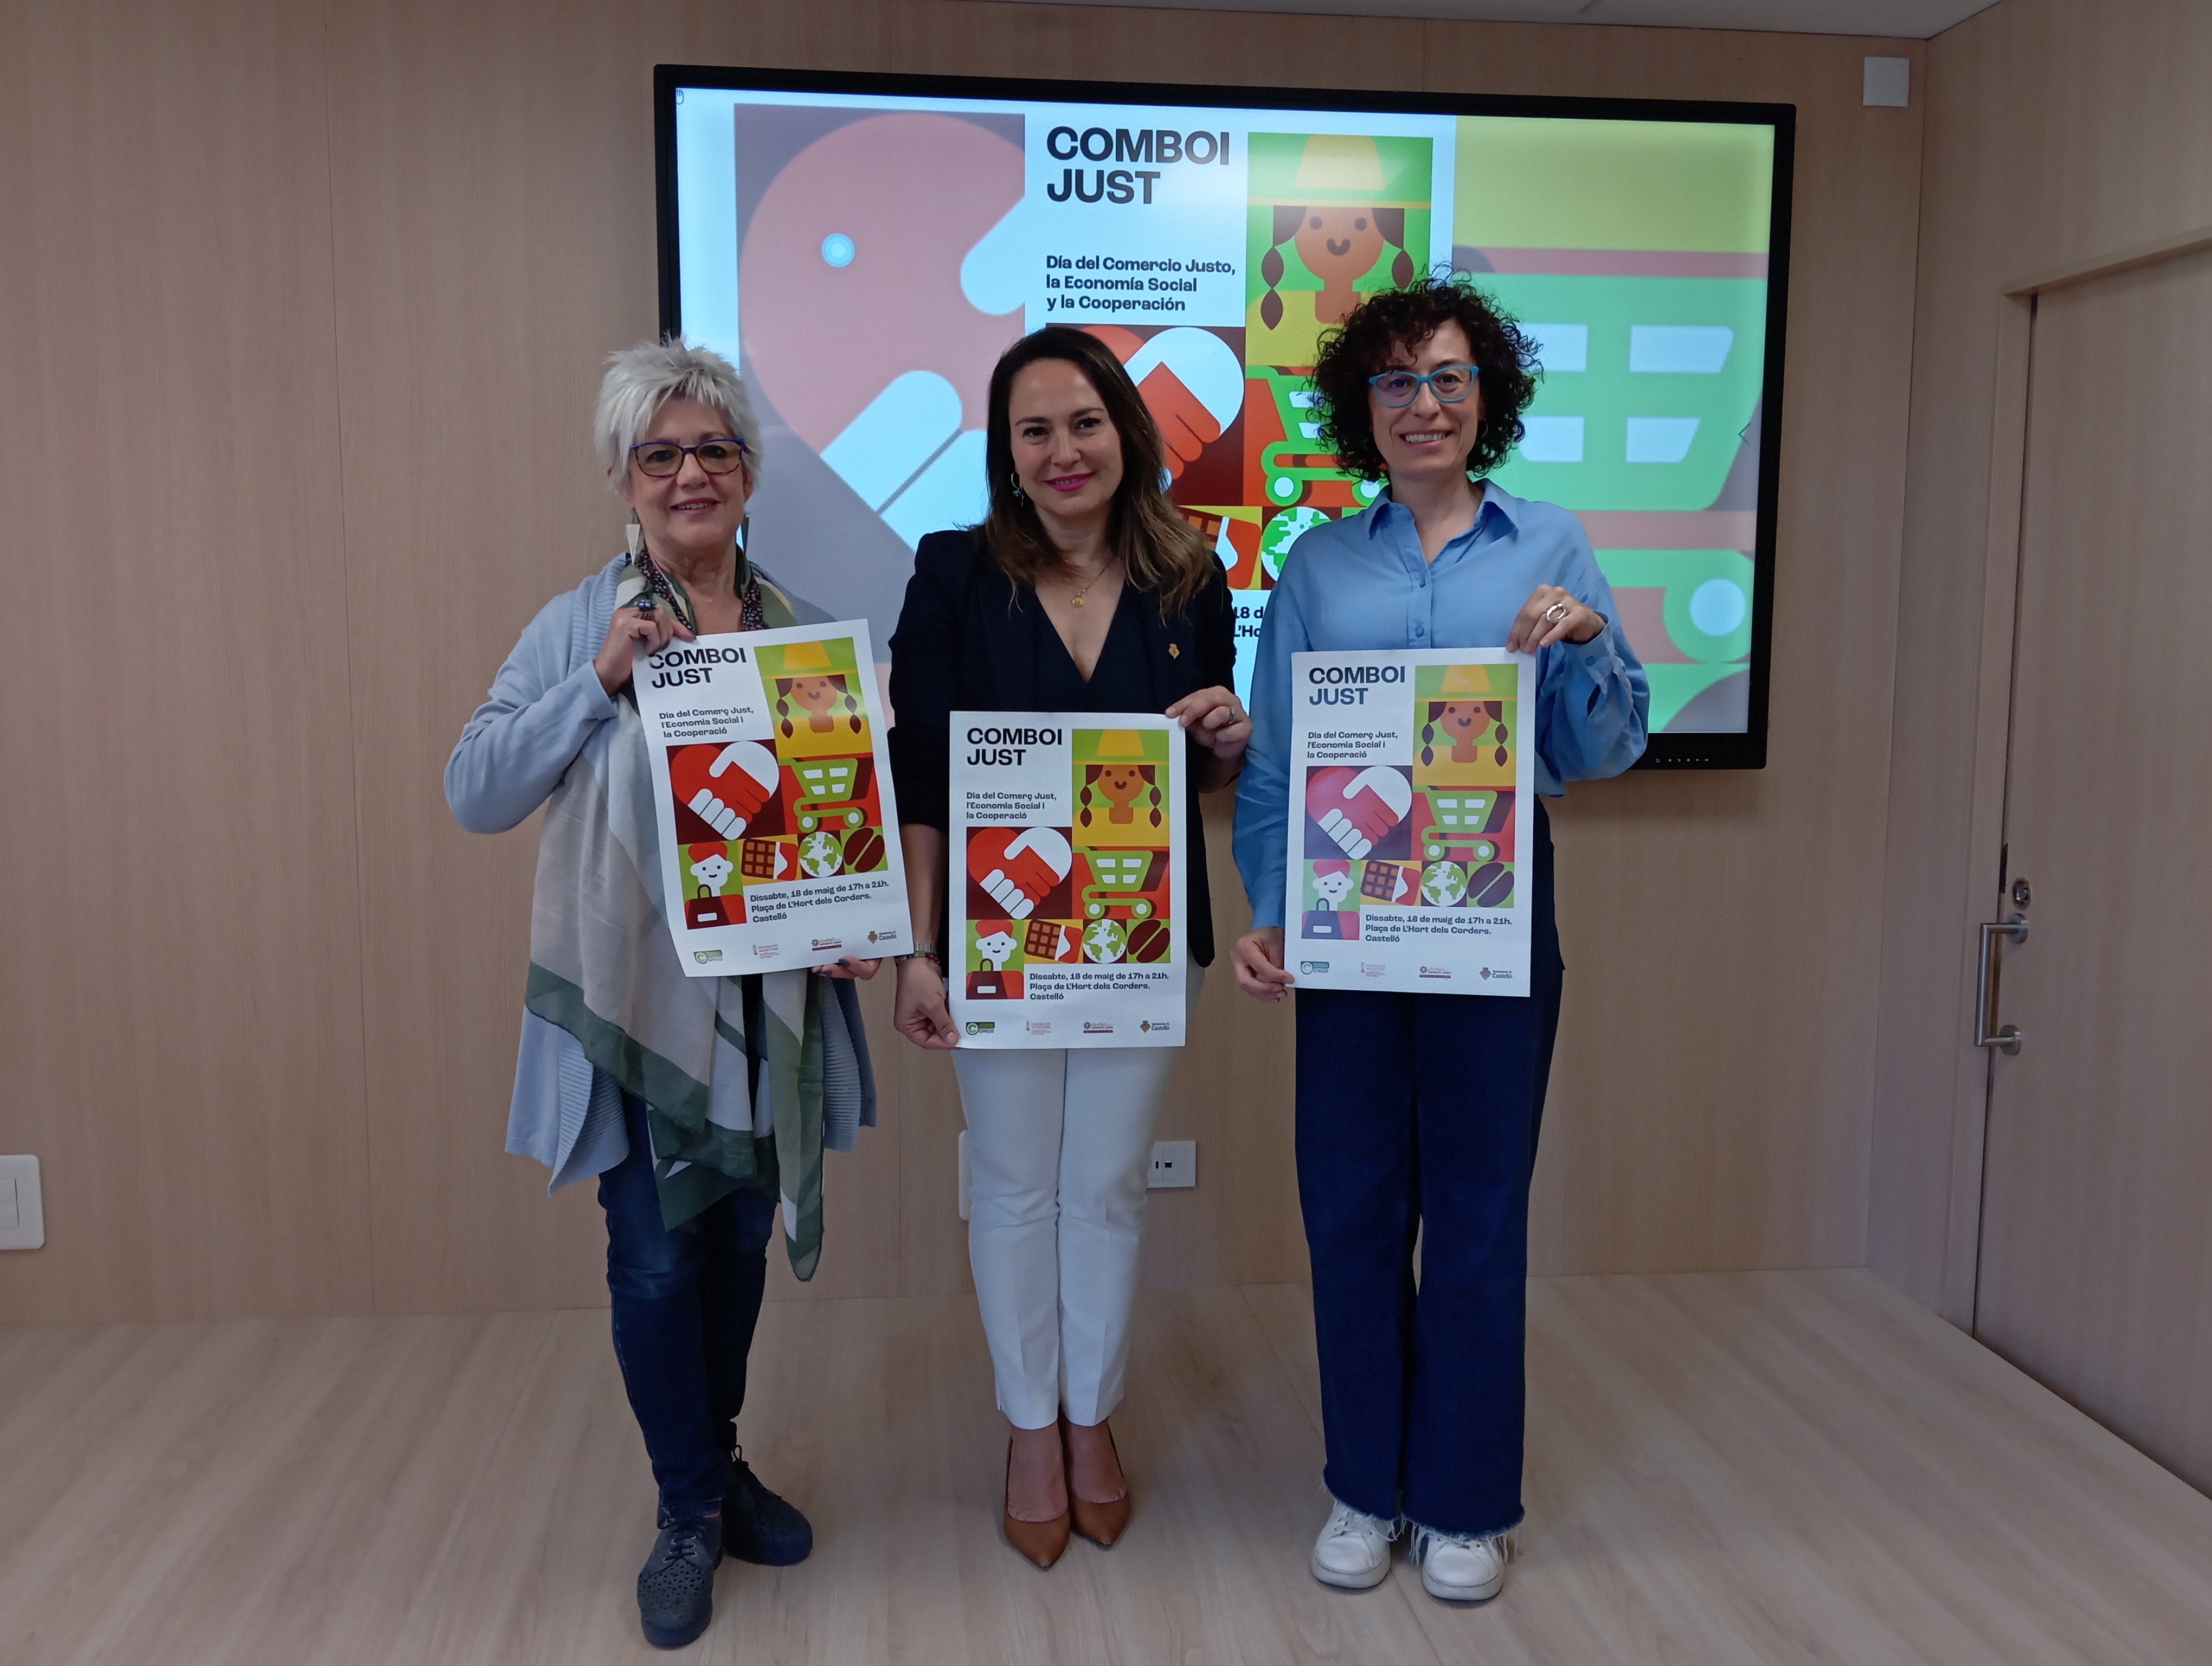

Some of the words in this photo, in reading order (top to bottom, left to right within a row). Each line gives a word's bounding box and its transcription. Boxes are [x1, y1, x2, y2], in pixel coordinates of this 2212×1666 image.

[1046, 126, 1230, 165] COMBOI
[1047, 169, 1160, 204] JUST
[1046, 255, 1072, 269] Día
[1076, 256, 1099, 270] del
[1103, 257, 1181, 272] Comercio
[1186, 260, 1235, 275] Justo,
[1046, 274, 1060, 289] la
[1064, 276, 1144, 291] Economía
[1148, 278, 1197, 291] Social
[1046, 298, 1057, 311] y
[1061, 295, 1075, 309] la
[1079, 296, 1185, 312] Cooperación
[1253, 606, 1263, 619] d
[648, 648, 746, 669] COMBOI
[652, 667, 712, 689] JUST
[1309, 665, 1405, 684] COMBOI
[1309, 688, 1368, 705] JUST
[677, 710, 691, 718] del
[692, 708, 729, 717] Comerç
[730, 707, 754, 715] Just,
[661, 717, 711, 728] l'Economia
[712, 716, 738, 725] Social
[674, 727, 726, 738] Cooperació
[967, 728, 1062, 745] COMBOI
[1338, 732, 1373, 740] Comerç
[967, 749, 1026, 765] JUST
[1316, 751, 1367, 759] Cooperació
[997, 792, 1032, 801] Comerç
[1034, 792, 1057, 800] Just,
[976, 811, 1027, 820] Cooperació
[750, 892, 789, 902] Dissabte,
[814, 886, 835, 896] maig
[836, 885, 846, 893] de
[848, 882, 863, 891] 17h
[872, 880, 889, 888] 21h.
[751, 904, 774, 913] Plaça
[788, 899, 814, 908] L'Hort
[815, 897, 832, 906] dels
[834, 893, 872, 902] Corders.
[753, 912, 787, 923] Castelló
[1366, 914, 1405, 924] Dissabte,
[1432, 916, 1452, 925] maig
[1455, 916, 1465, 924] de
[1366, 925, 1388, 934] Plaça
[1451, 926, 1491, 934] Corders.
[1366, 934, 1400, 943] Castelló
[1030, 972, 1068, 981] Dissabte,
[1094, 972, 1114, 981] maig
[1030, 983, 1052, 991] Plaça
